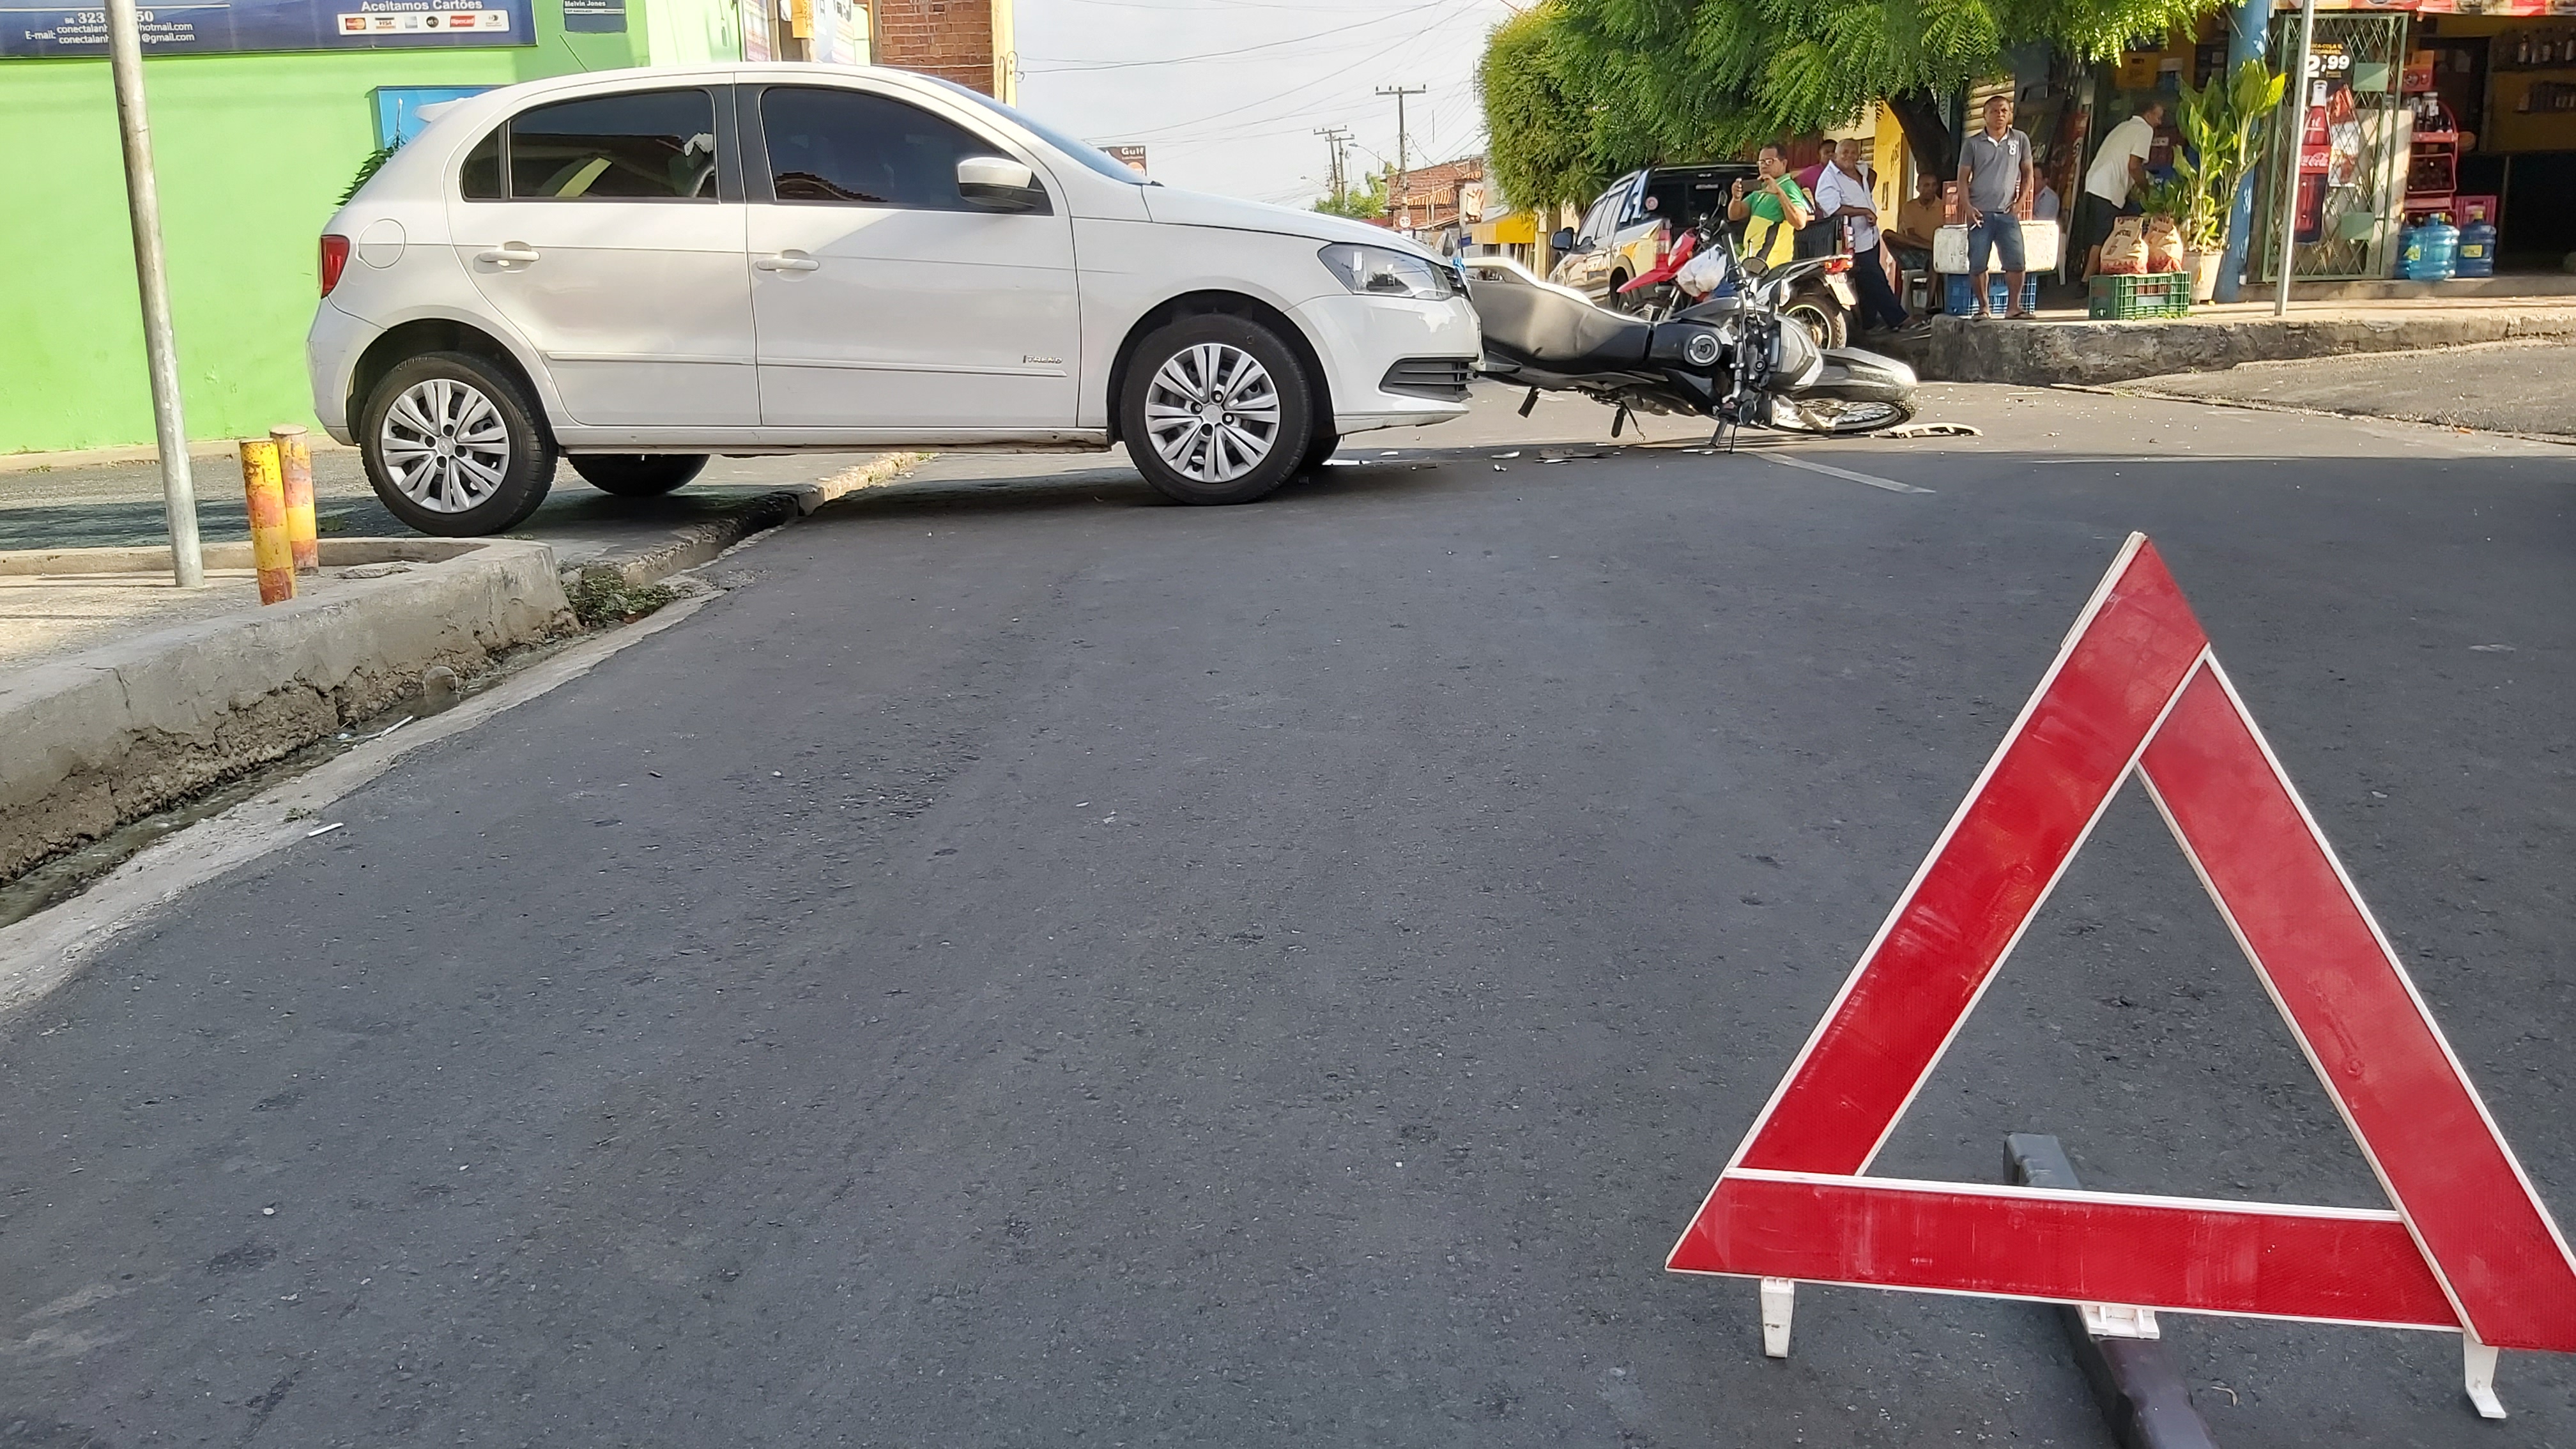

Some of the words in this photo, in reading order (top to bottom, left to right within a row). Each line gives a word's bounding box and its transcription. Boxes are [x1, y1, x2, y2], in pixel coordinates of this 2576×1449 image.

[361, 1, 429, 12] Aceitamos
[433, 0, 483, 10] Cartões
[25, 31, 56, 41] E-mail:
[1121, 147, 1144, 155] Gulf
[2009, 143, 2017, 155] 8
